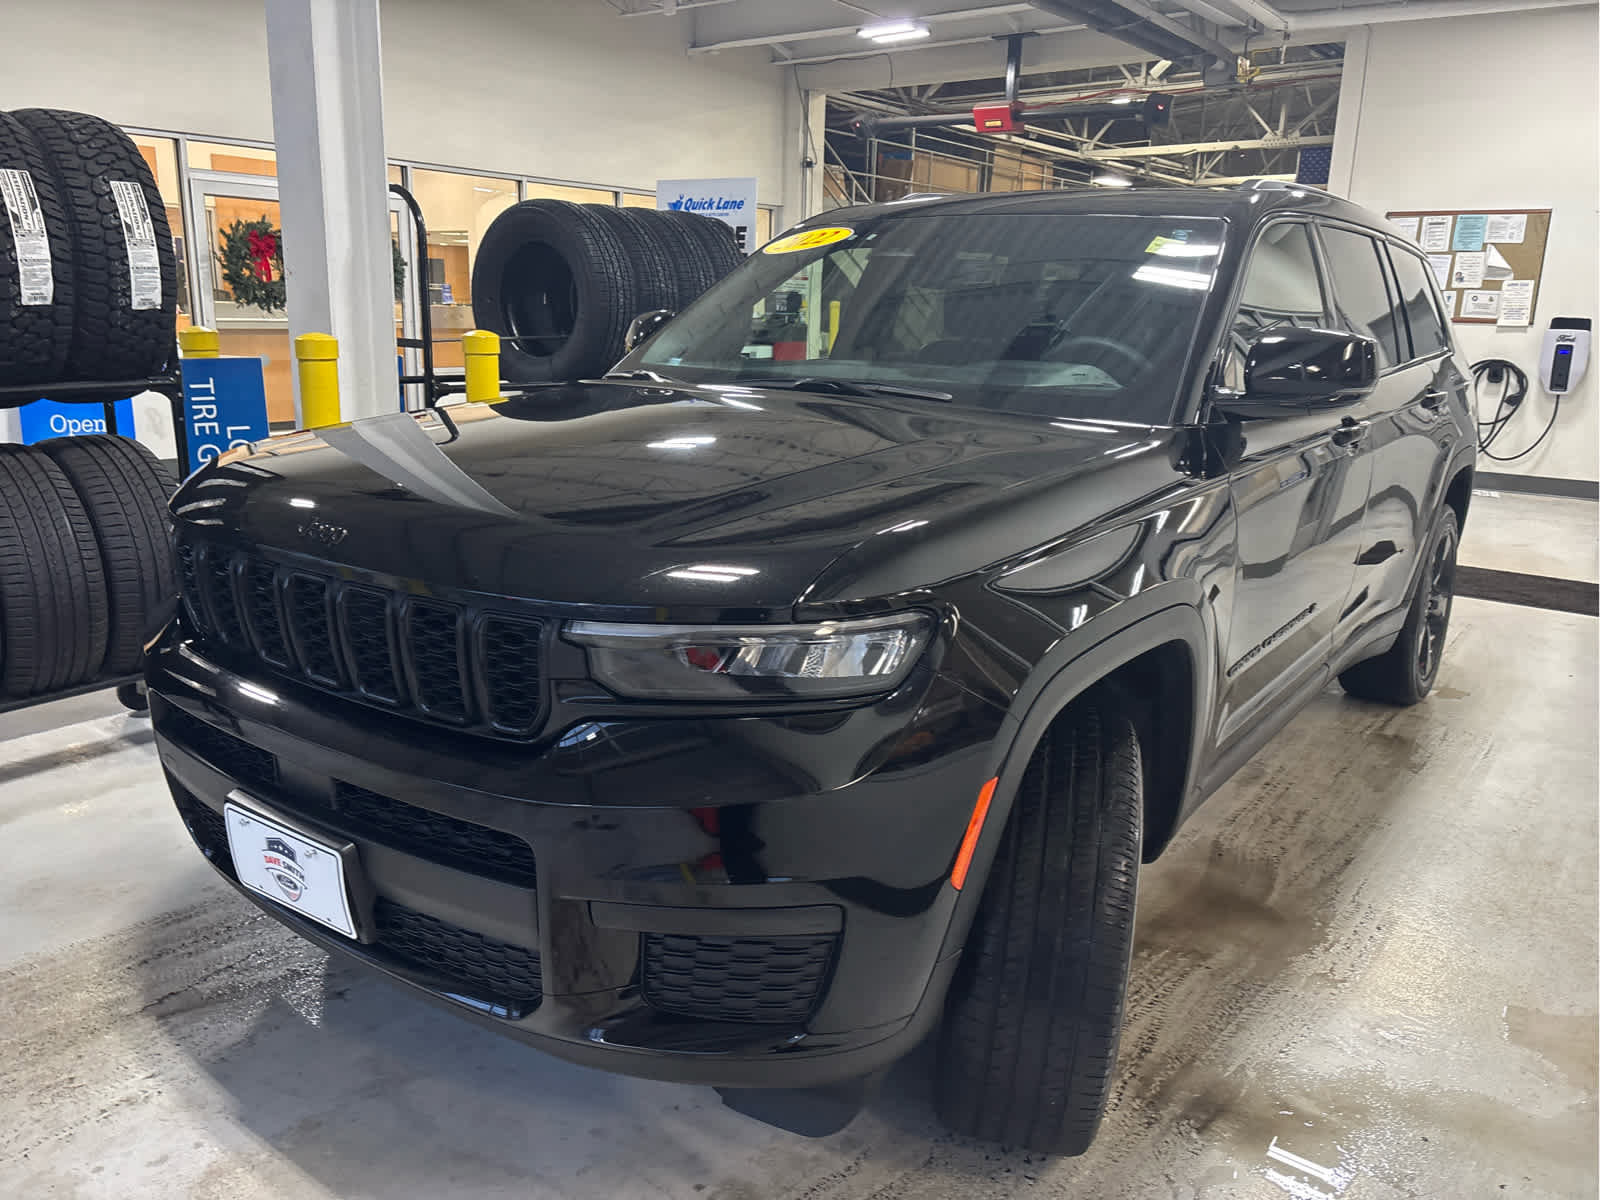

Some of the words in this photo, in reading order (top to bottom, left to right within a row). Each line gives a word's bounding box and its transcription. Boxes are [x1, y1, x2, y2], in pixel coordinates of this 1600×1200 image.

[684, 197, 714, 212] Quick
[716, 197, 744, 210] Lane
[189, 377, 220, 436] TIRE
[50, 414, 107, 436] Open
